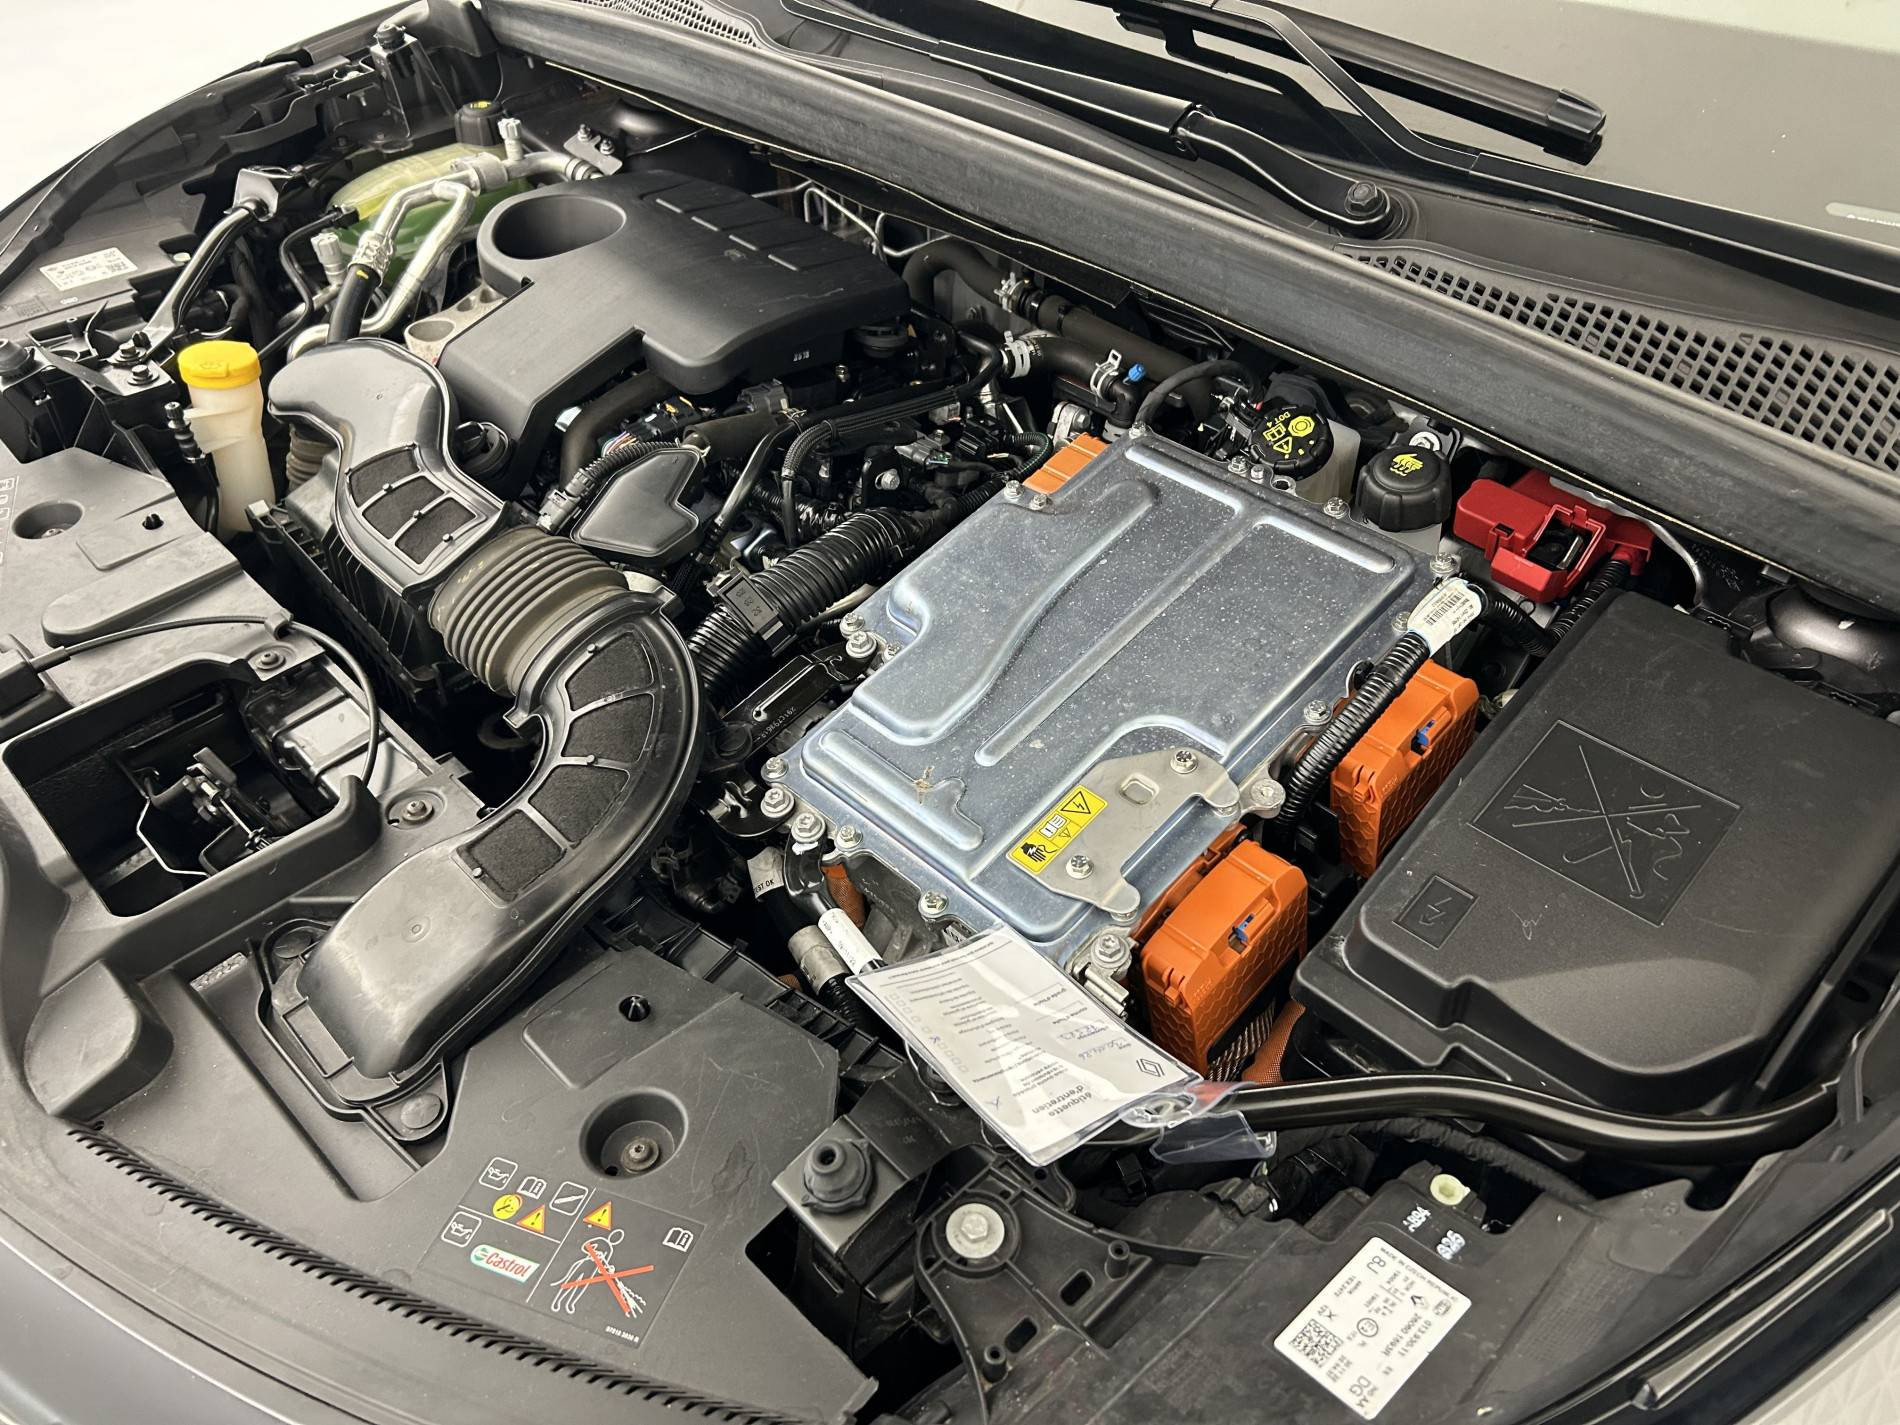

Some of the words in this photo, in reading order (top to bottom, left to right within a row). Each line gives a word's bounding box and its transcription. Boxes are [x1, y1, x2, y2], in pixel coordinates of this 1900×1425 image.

[1274, 411, 1291, 425] DOT
[765, 879, 775, 887] OK
[484, 1251, 532, 1278] Castrol
[1365, 1255, 1387, 1274] 8J
[1348, 1374, 1372, 1395] DG
